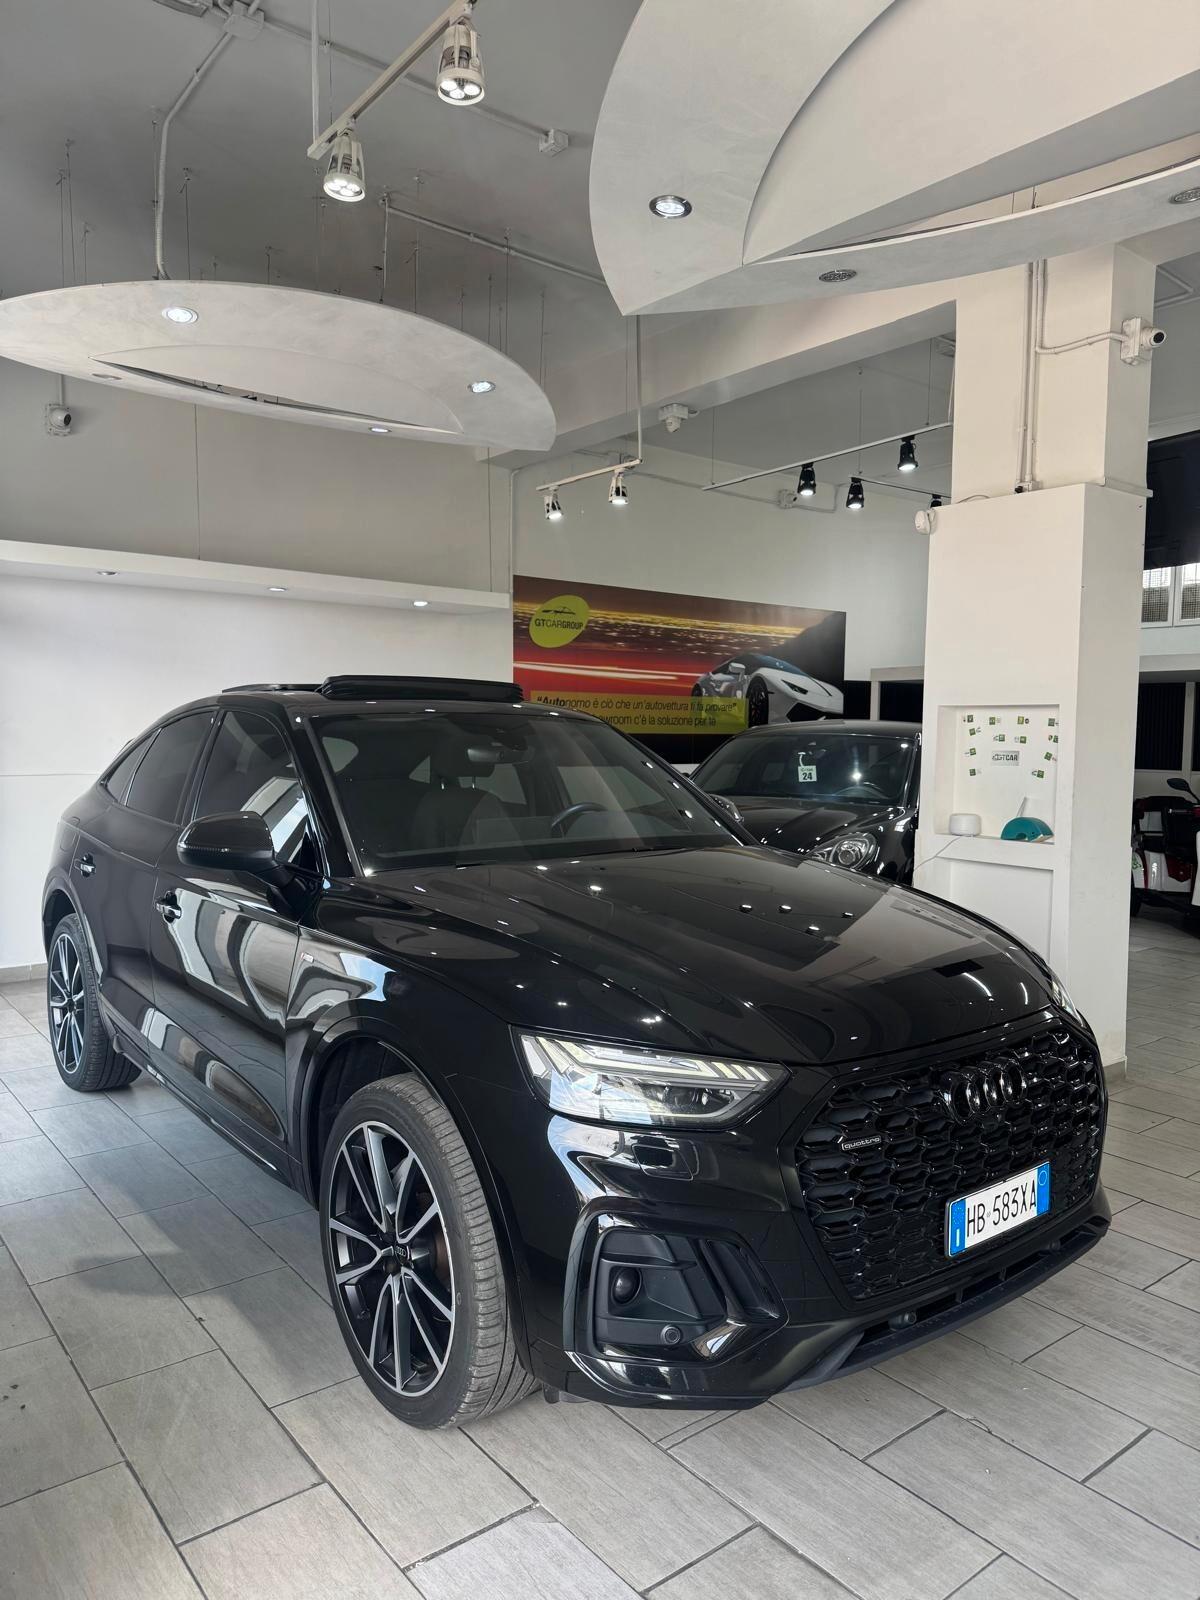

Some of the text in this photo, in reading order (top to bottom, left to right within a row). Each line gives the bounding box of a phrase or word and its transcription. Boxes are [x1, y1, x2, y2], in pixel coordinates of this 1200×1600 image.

[616, 701, 630, 709] che
[648, 714, 656, 726] la
[657, 714, 694, 727] soluzione
[694, 716, 706, 728] per
[802, 772, 813, 781] 24
[845, 1137, 880, 1149] quattro
[967, 1180, 1037, 1237] HB 583XA
